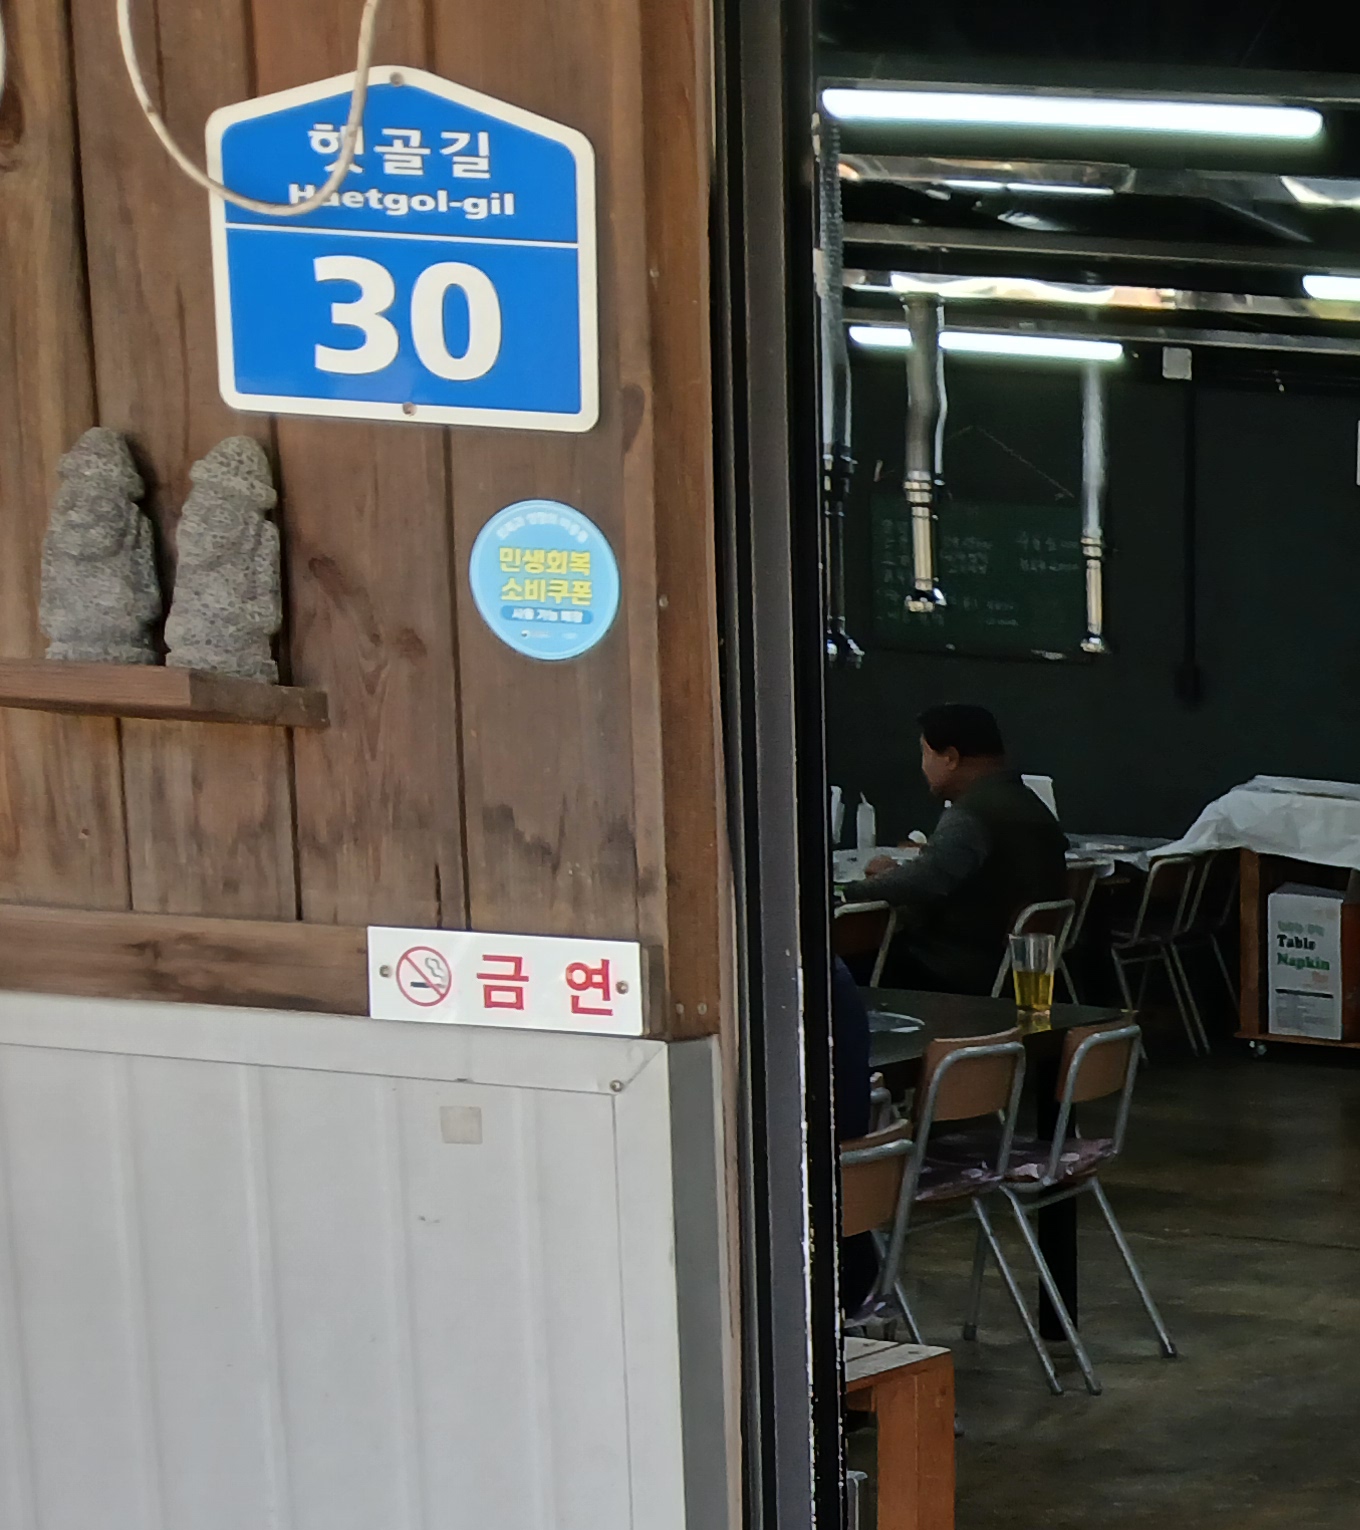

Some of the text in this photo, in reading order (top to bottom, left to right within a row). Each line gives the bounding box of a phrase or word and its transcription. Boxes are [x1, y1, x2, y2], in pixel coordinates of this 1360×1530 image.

[313, 255, 501, 381] 30
[499, 547, 591, 576] 민생회복
[501, 578, 592, 605] 소비쿠폰
[1277, 934, 1316, 950] Table
[1277, 953, 1330, 970] Napkin
[477, 954, 613, 1016] 금연
